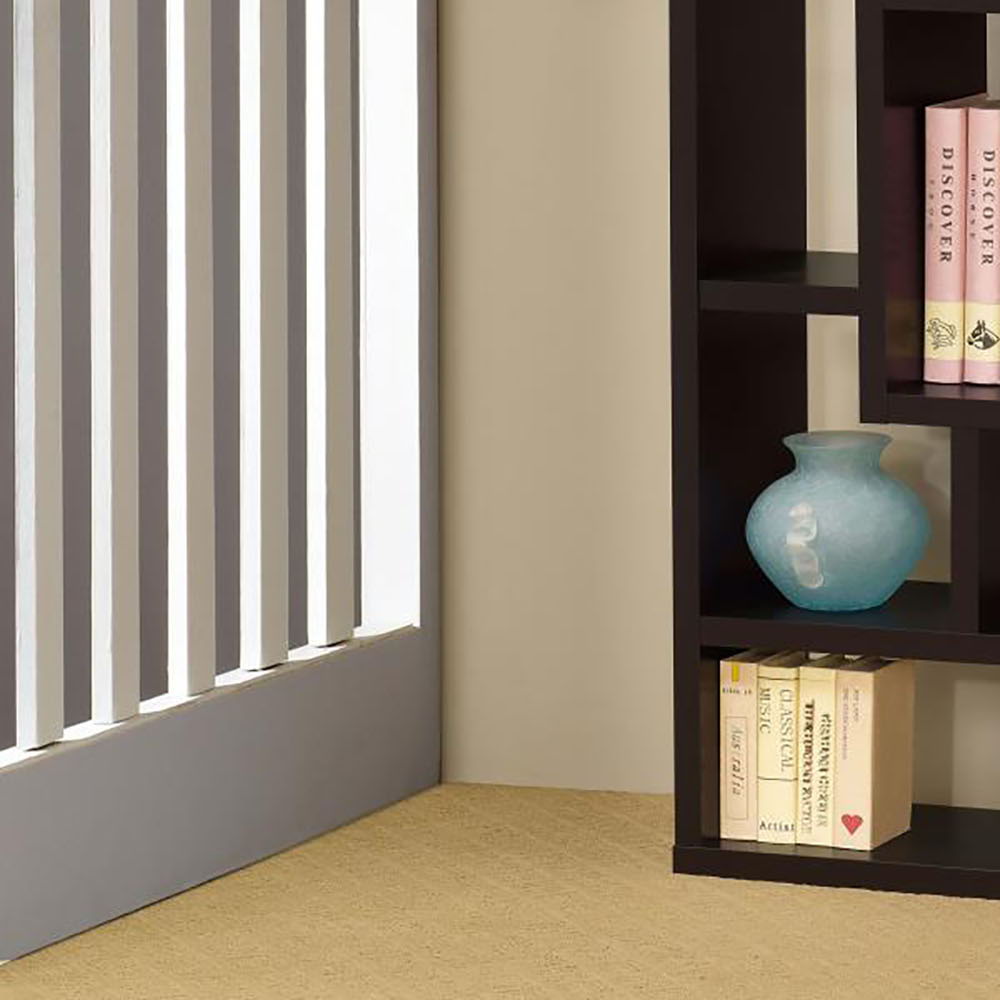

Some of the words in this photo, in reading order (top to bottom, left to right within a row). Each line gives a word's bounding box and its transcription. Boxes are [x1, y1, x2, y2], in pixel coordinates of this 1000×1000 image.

[940, 147, 954, 263] DISCOVER
[982, 150, 996, 266] DISCOVER
[759, 687, 772, 734] MUSIC
[779, 688, 795, 773] CLASSICAL
